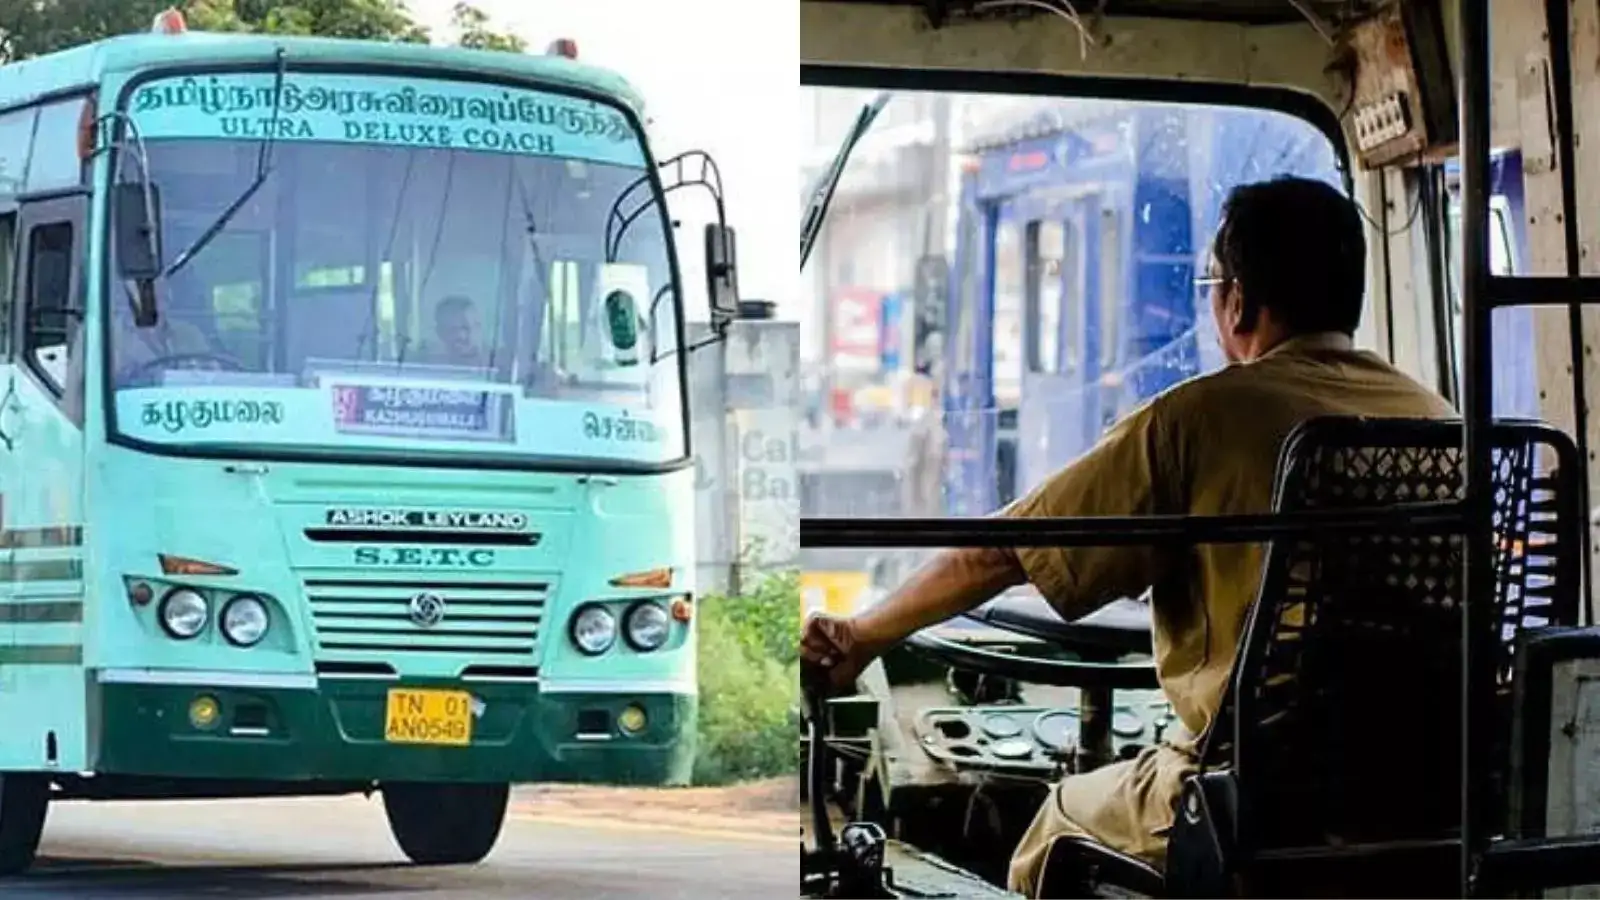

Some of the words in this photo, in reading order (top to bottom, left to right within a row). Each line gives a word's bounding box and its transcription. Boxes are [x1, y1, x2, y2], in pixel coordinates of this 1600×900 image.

[219, 117, 314, 138] ULTRA
[344, 119, 451, 146] DELUXE
[463, 127, 555, 152] COACH
[141, 400, 284, 433] கழுகுமலை
[330, 509, 408, 525] ASHOK
[422, 510, 527, 529] LEYLAND
[355, 547, 495, 567] S.E.T.C
[394, 693, 424, 714] TN
[445, 696, 468, 716] 01
[387, 717, 466, 738] AN0549
